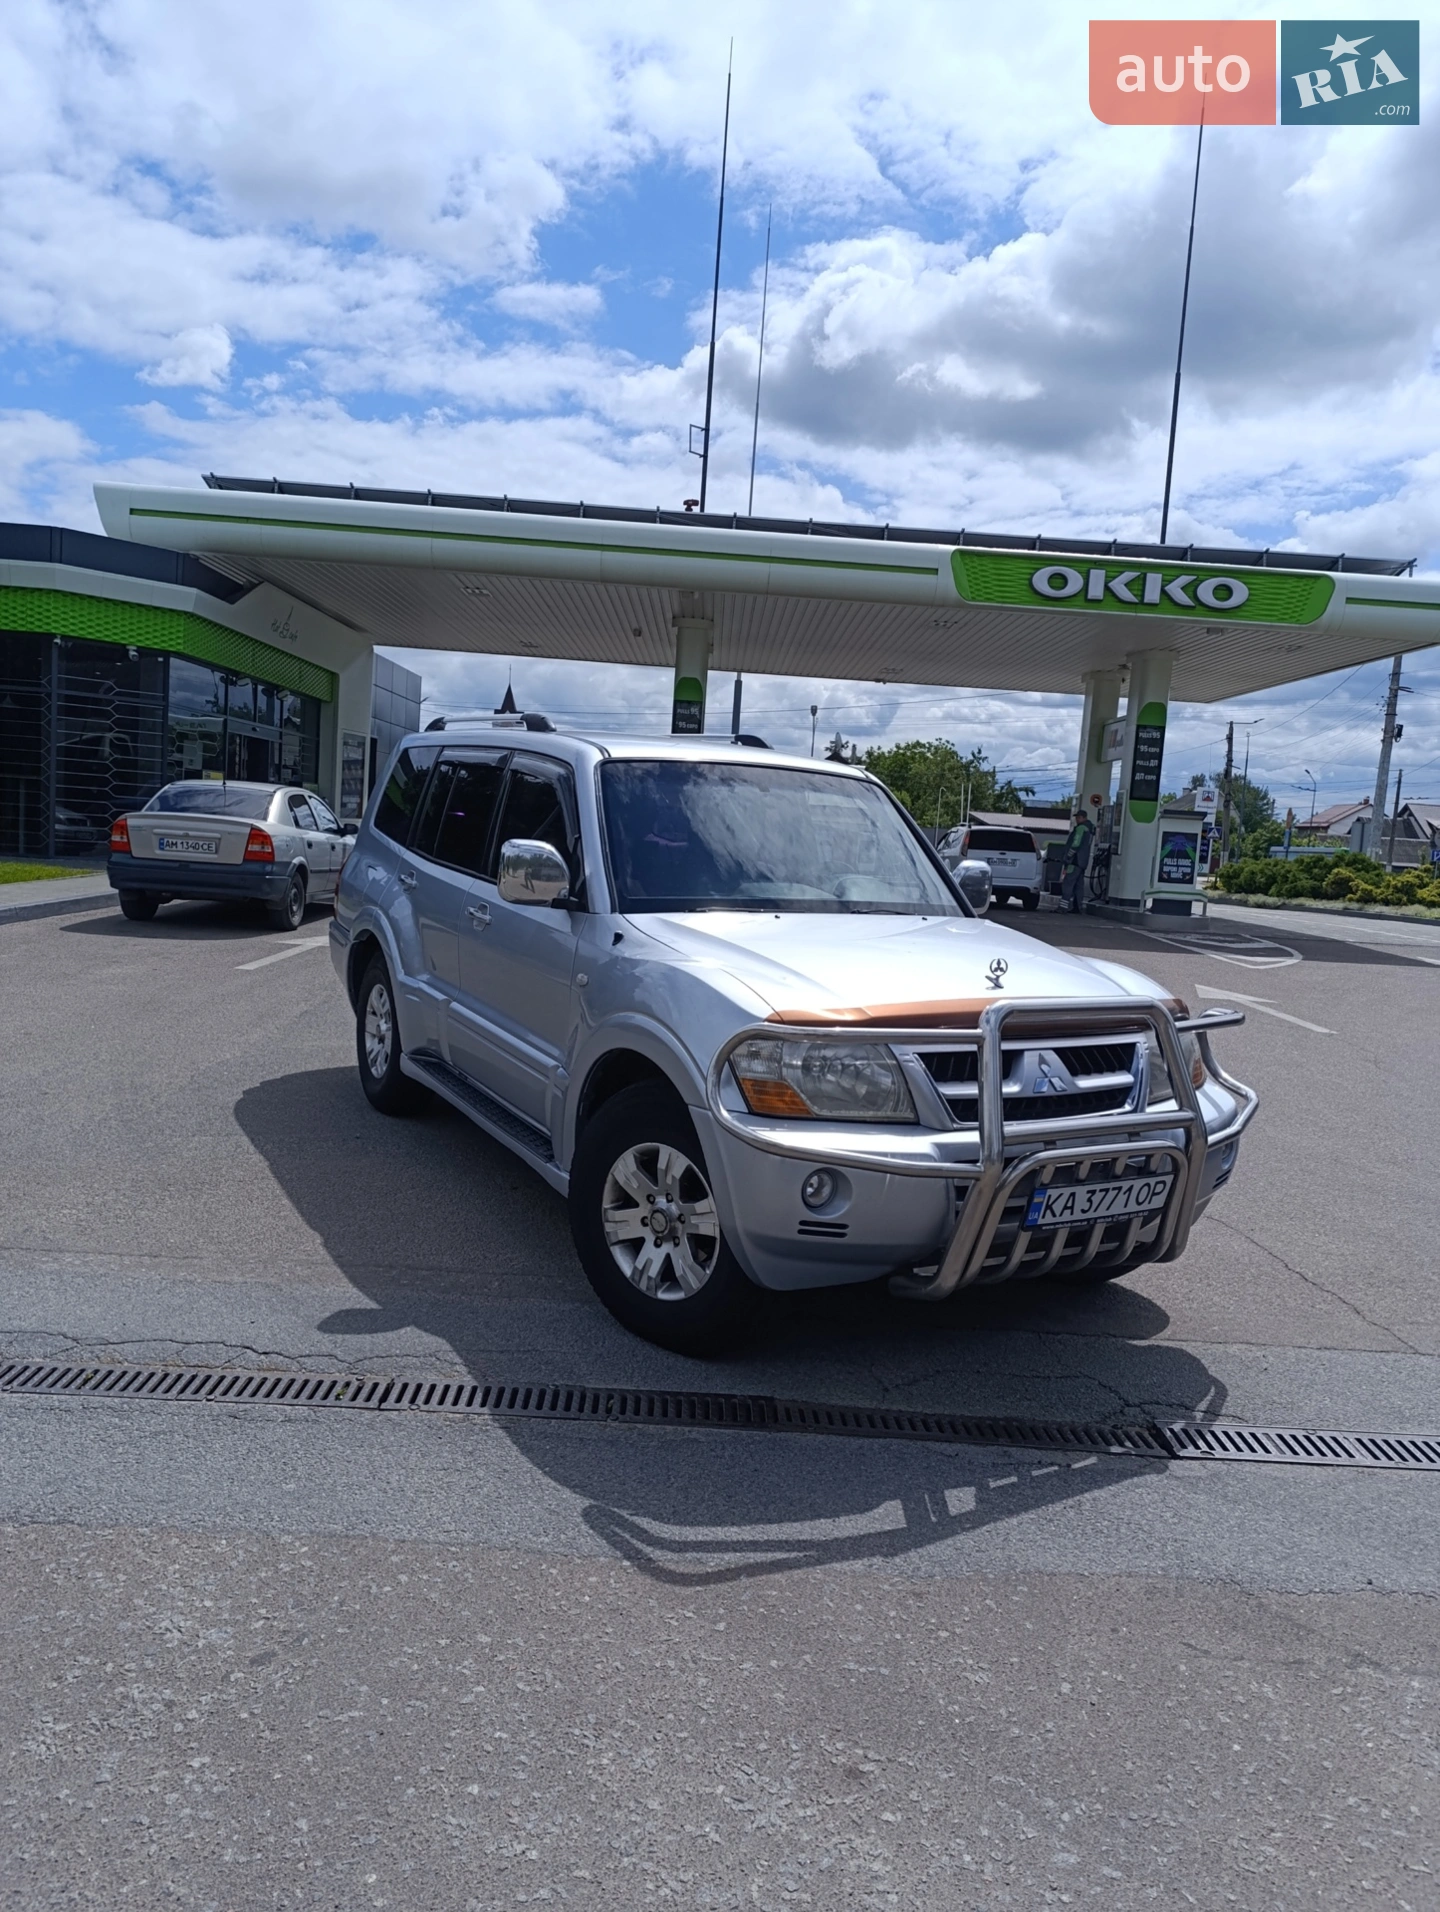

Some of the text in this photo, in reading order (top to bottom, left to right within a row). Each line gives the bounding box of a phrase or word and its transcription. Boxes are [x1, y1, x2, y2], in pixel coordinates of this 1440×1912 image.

[1030, 565, 1250, 610] OKKO
[690, 707, 699, 715] 95
[1152, 731, 1161, 739] 95
[165, 839, 214, 852] AM 1340 CE
[1041, 1179, 1167, 1220] KA 3771 OP
[1028, 1211, 1039, 1220] UA
